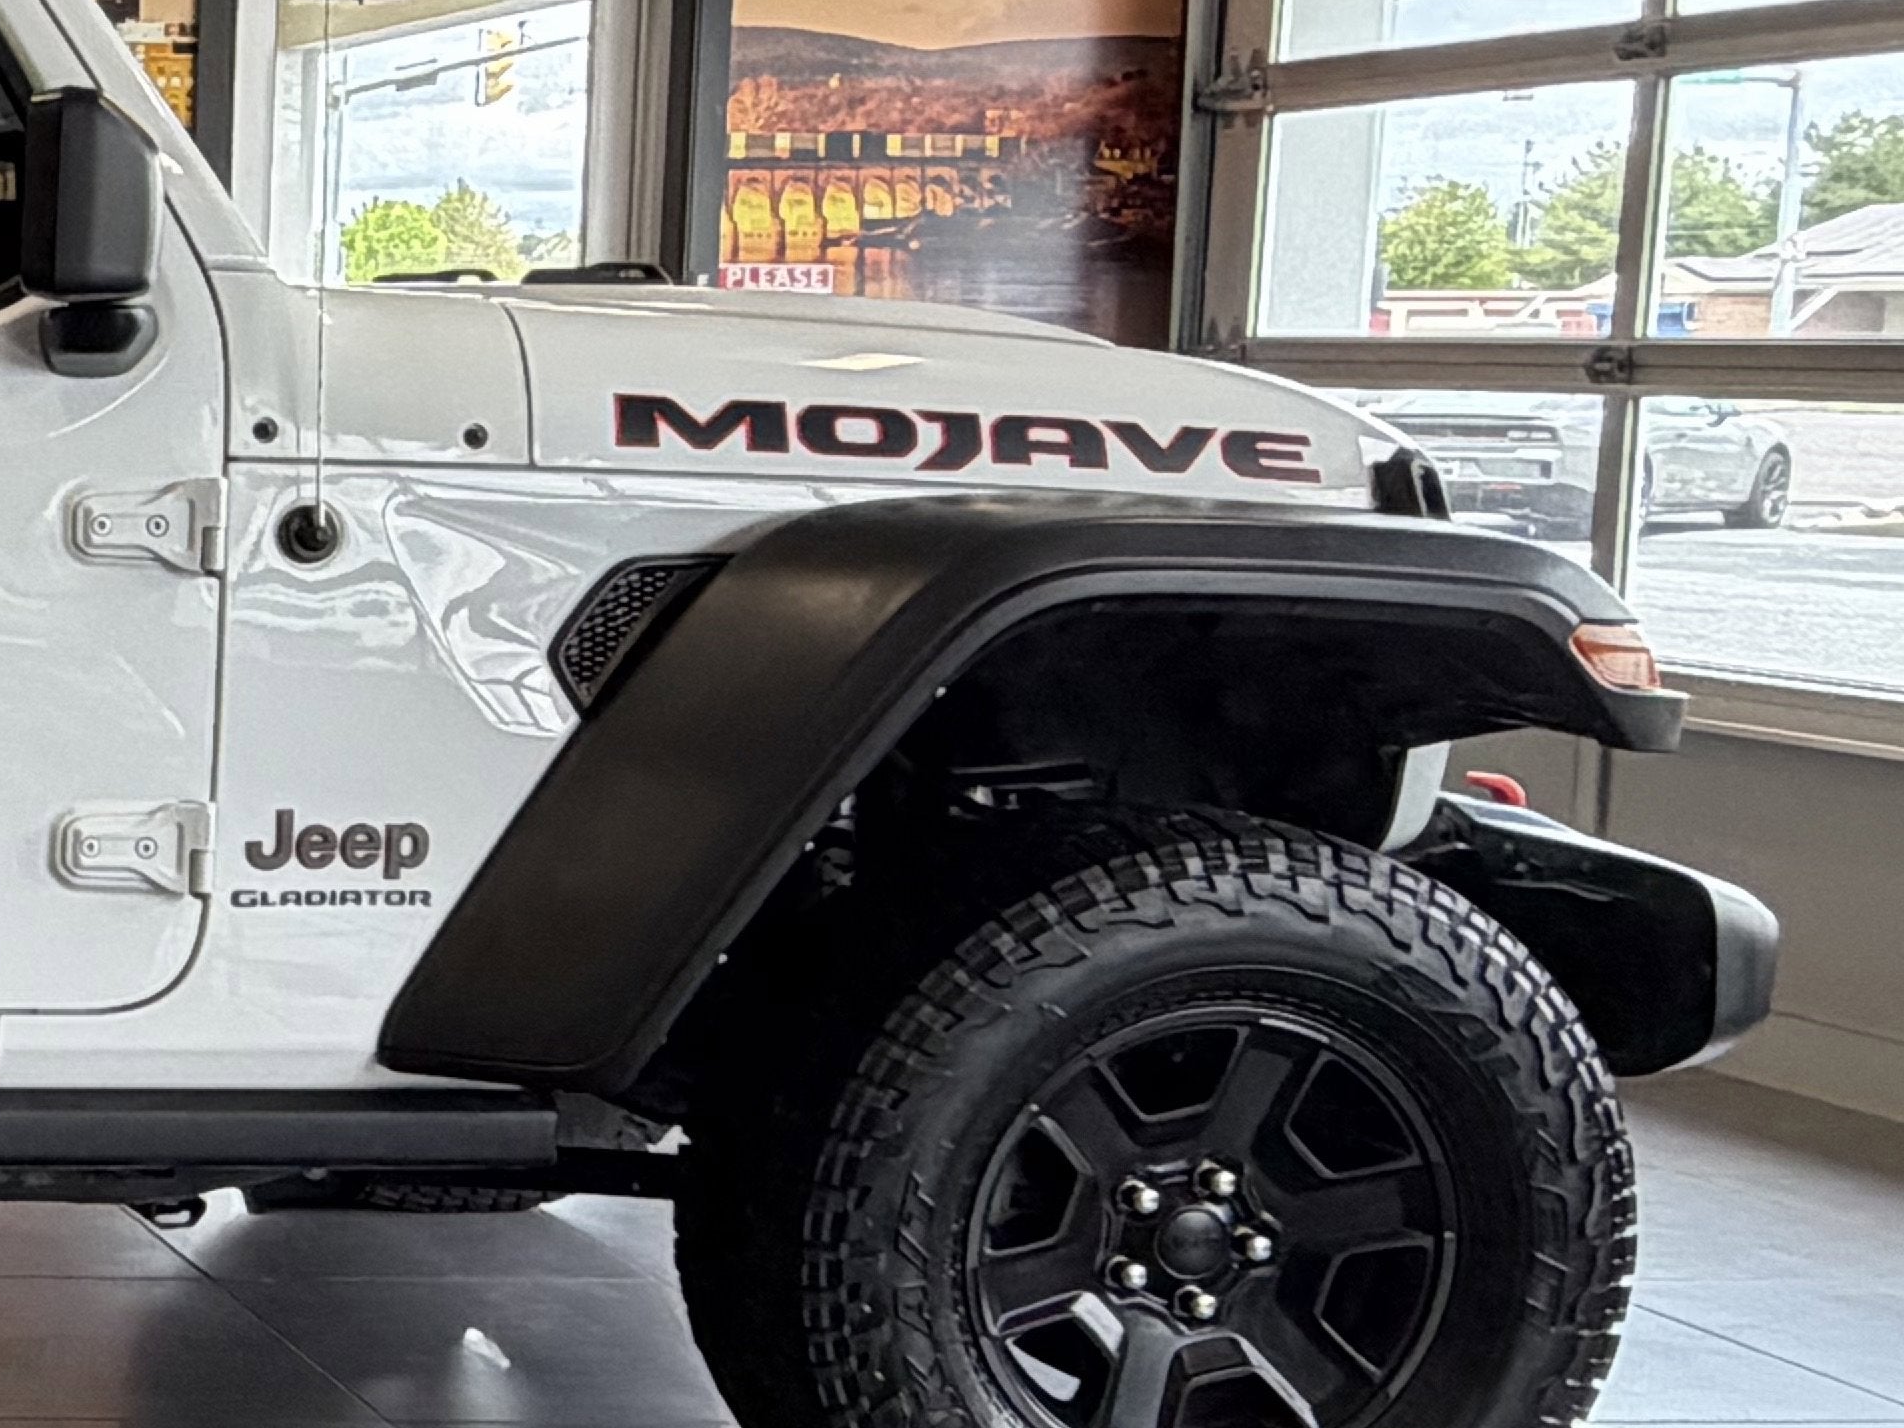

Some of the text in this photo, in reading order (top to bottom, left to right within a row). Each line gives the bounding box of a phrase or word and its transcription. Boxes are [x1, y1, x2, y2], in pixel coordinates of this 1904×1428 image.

[726, 266, 831, 292] PLEASE
[612, 392, 1322, 484] MOJAVE
[245, 808, 430, 880] Jeep
[230, 889, 432, 908] GLADIATOR
